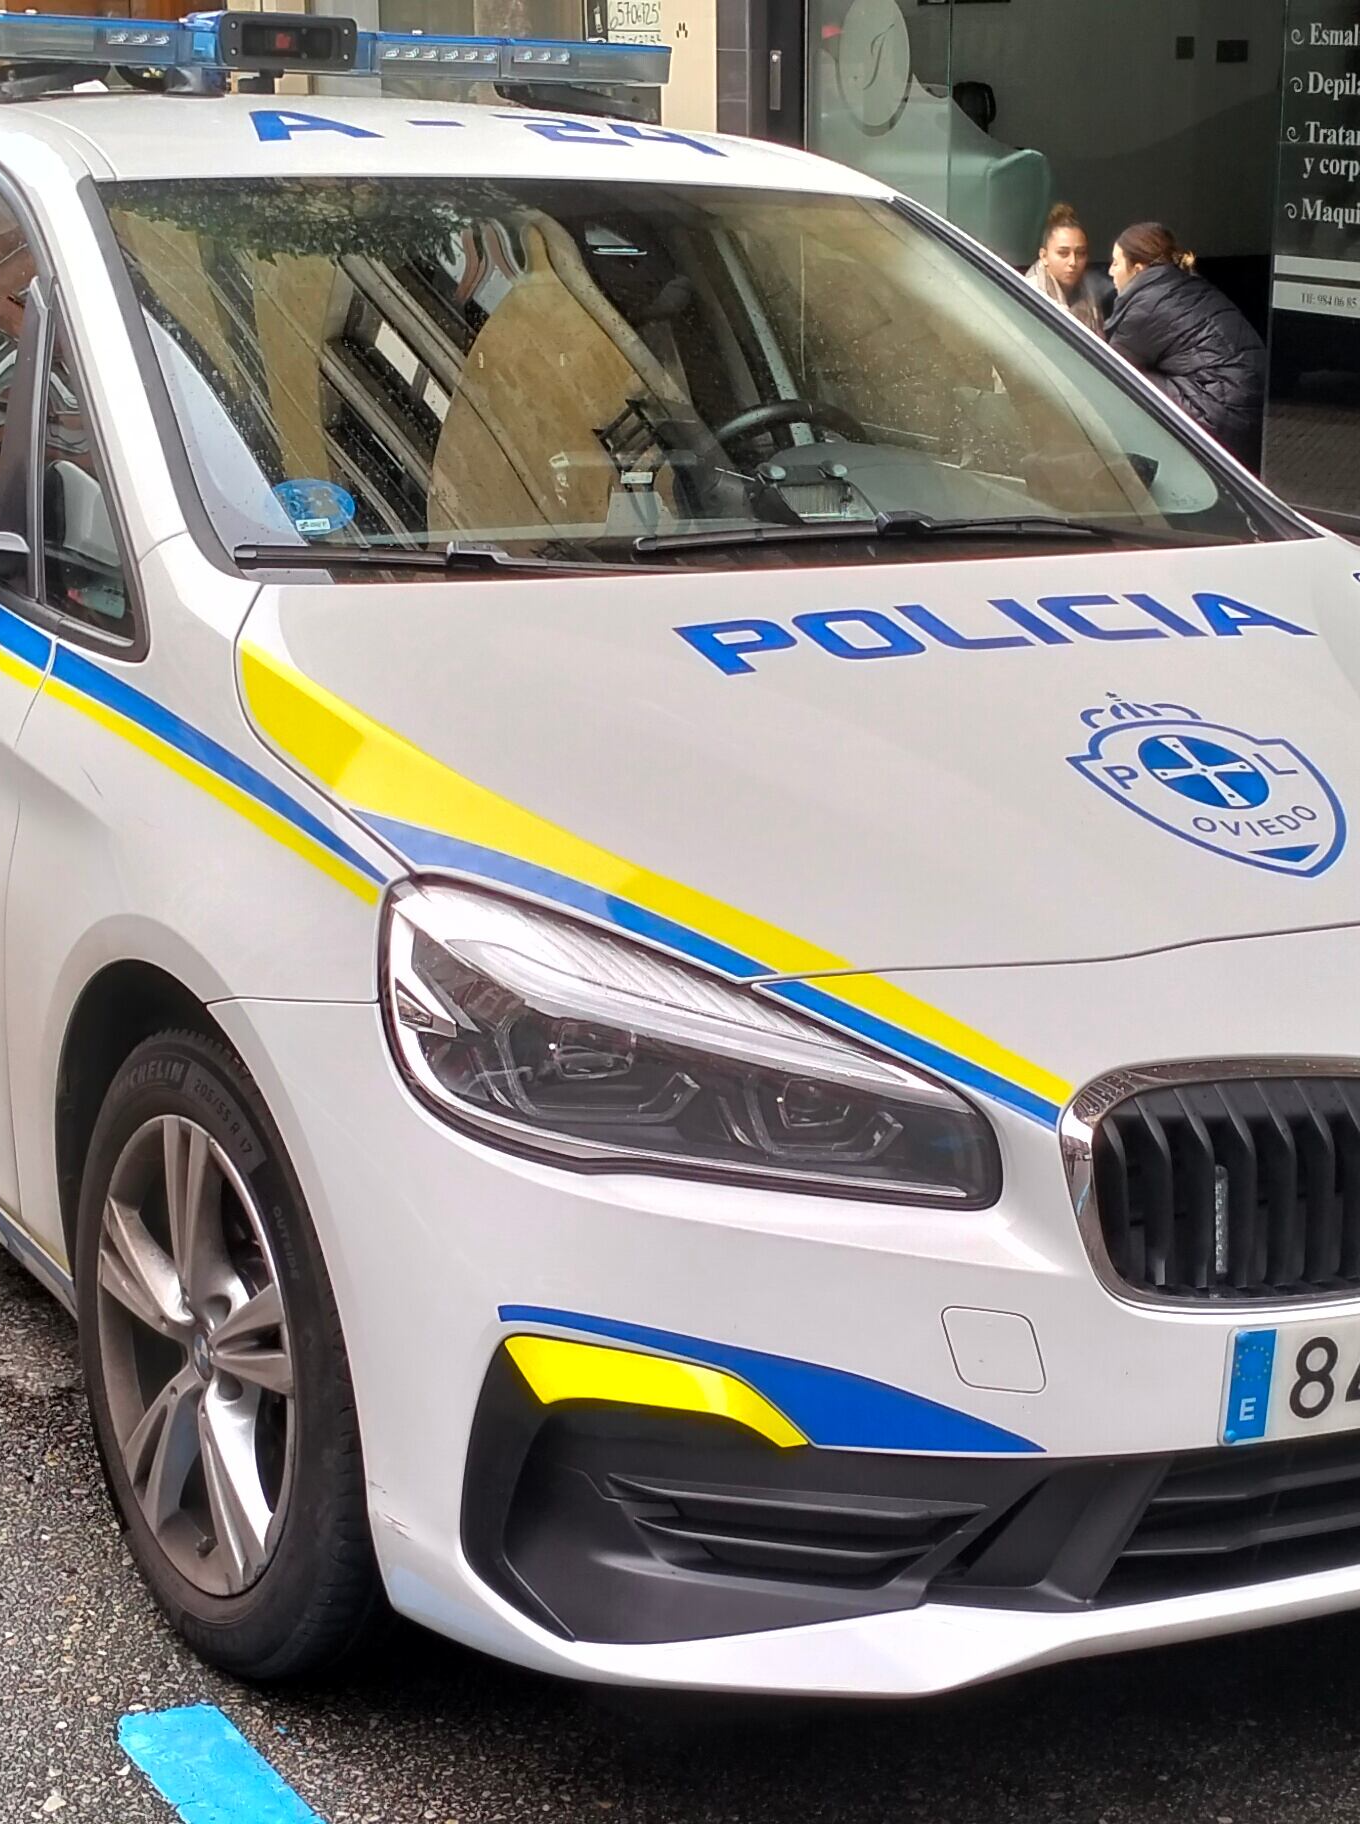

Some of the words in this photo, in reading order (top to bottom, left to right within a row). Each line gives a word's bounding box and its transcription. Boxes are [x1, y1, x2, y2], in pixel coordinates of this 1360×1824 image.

[248, 110, 386, 142] A
[490, 113, 729, 157] 24
[1303, 157, 1315, 178] y
[671, 592, 1319, 677] POLICIA
[1102, 765, 1139, 790] P
[1252, 753, 1299, 775] L
[1192, 805, 1318, 837] OVIEDO
[193, 1079, 232, 1123] 205/55
[1240, 1397, 1257, 1421] E
